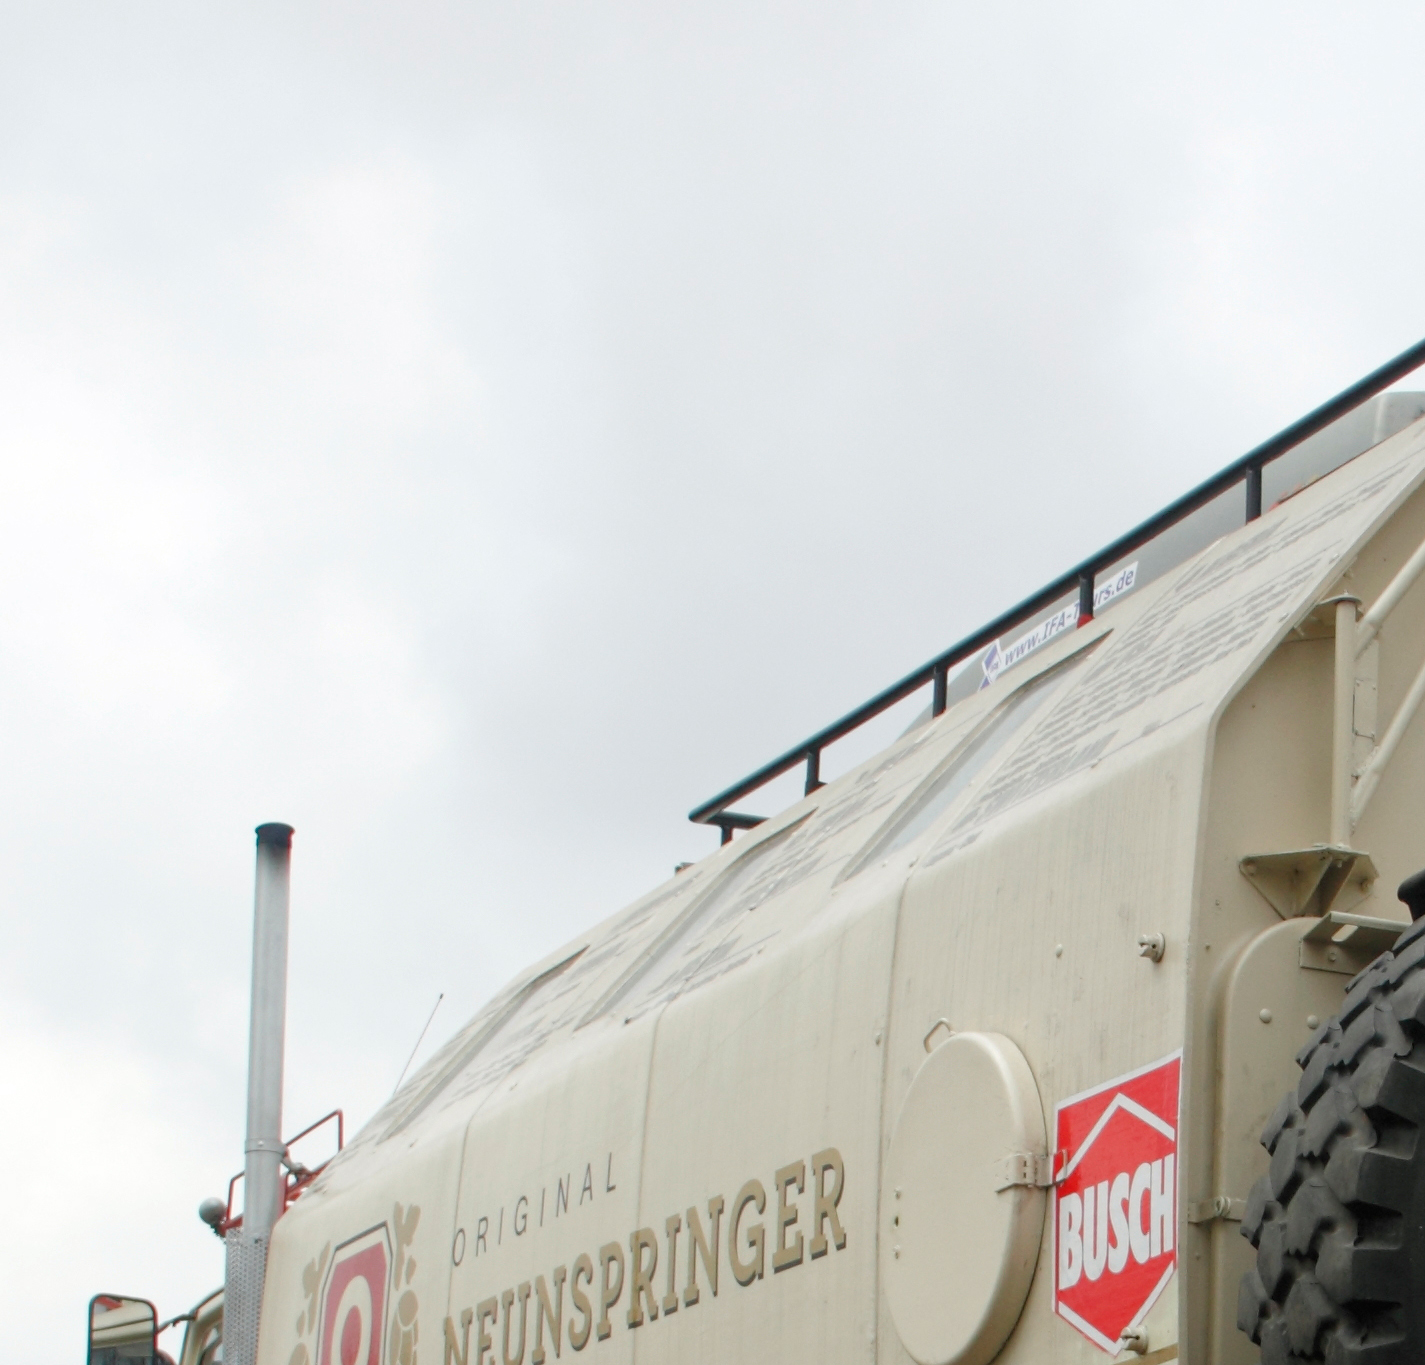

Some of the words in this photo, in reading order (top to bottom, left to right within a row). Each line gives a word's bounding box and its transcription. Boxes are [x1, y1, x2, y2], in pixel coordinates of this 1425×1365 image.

[1004, 569, 1134, 666] www.IFA-Turs.de
[452, 1152, 616, 1267] ORIGINAL
[1059, 1153, 1174, 1290] BUSCH
